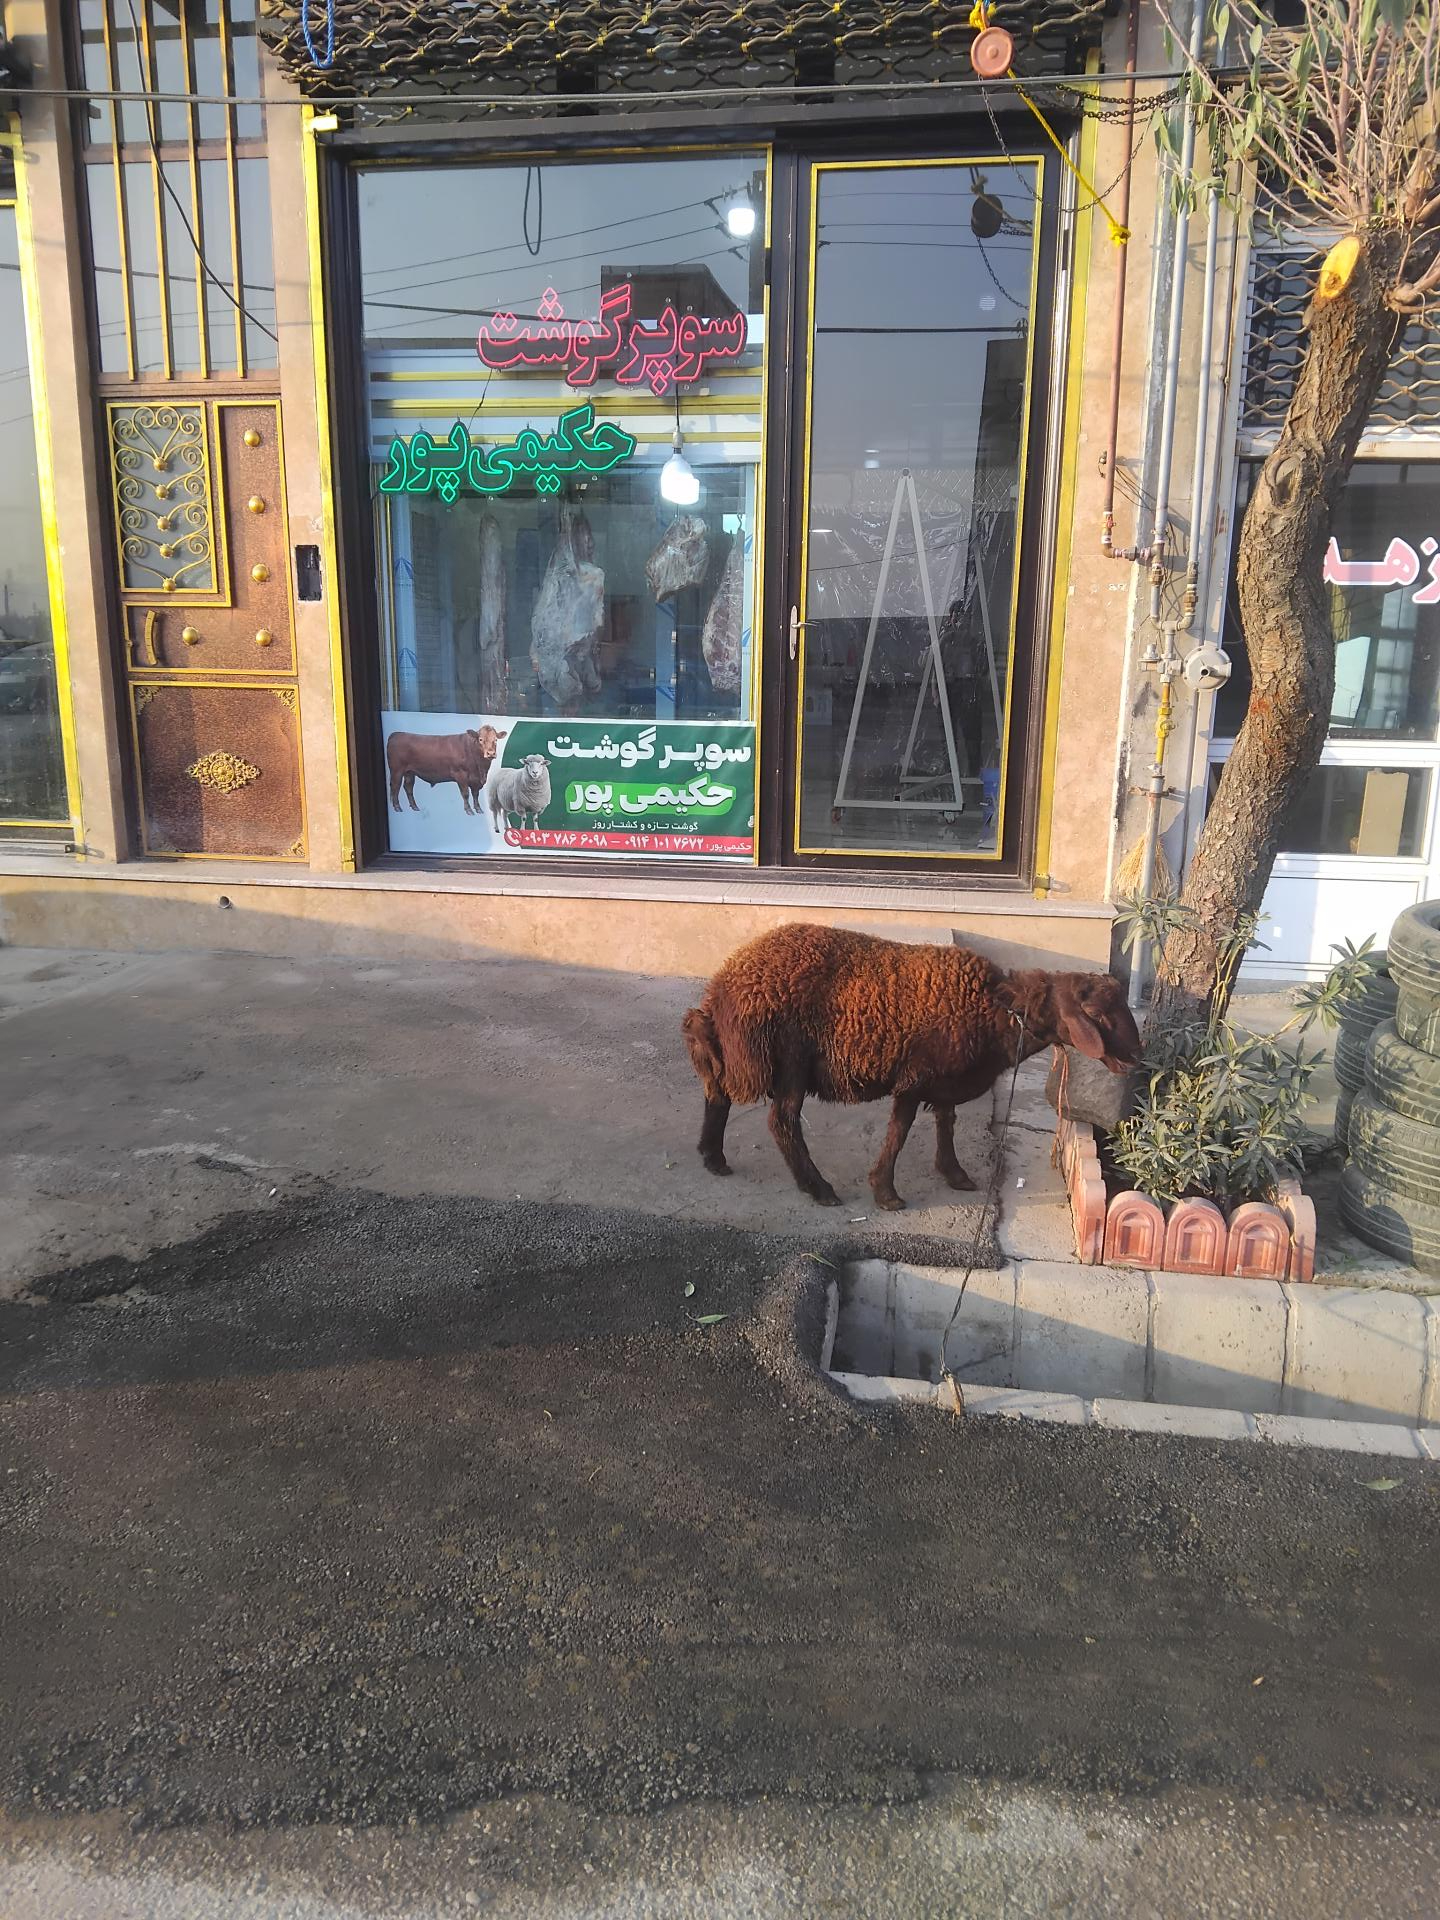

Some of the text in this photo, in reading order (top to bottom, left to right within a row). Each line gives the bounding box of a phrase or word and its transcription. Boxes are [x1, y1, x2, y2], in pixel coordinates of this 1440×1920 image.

[478, 283, 745, 396] سوپر گوشت
[379, 403, 637, 502] حکیمی پور
[547, 725, 751, 772] سوپر گوشت
[569, 777, 733, 814] حکیمی پور
[592, 819, 699, 832] گوشت تازه و کشتار روز
[554, 832, 577, 845] ۷۸۶
[580, 833, 608, 847] ۶۰۹۸
[625, 835, 650, 848] ۰۹۱۴
[654, 836, 669, 848] ۱۰۱
